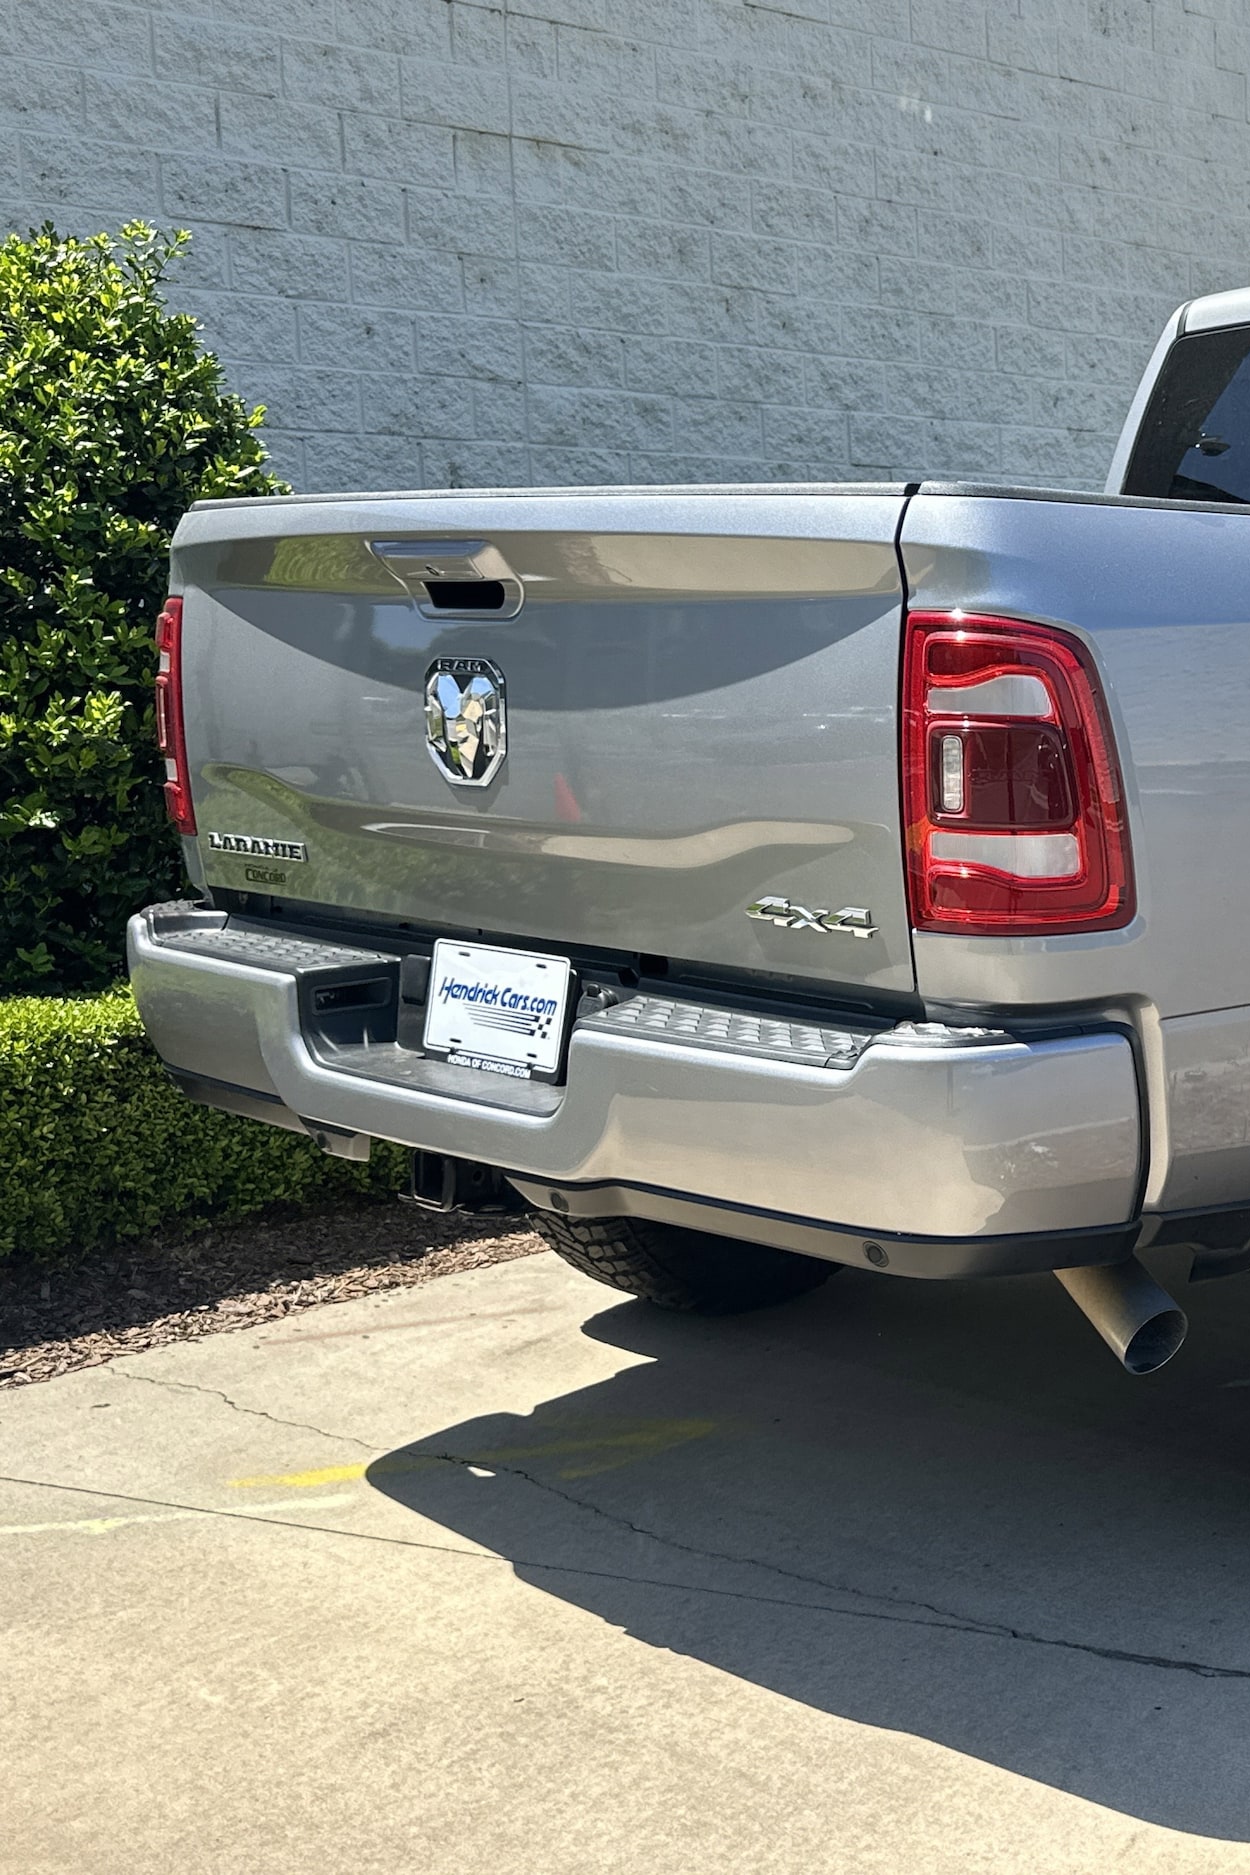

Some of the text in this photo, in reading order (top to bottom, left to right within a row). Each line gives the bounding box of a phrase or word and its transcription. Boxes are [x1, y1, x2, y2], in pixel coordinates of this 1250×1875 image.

[437, 660, 481, 672] RAM
[208, 831, 308, 862] LARAMIE
[447, 1054, 531, 1079] HONDA OF CONCORD.COM
